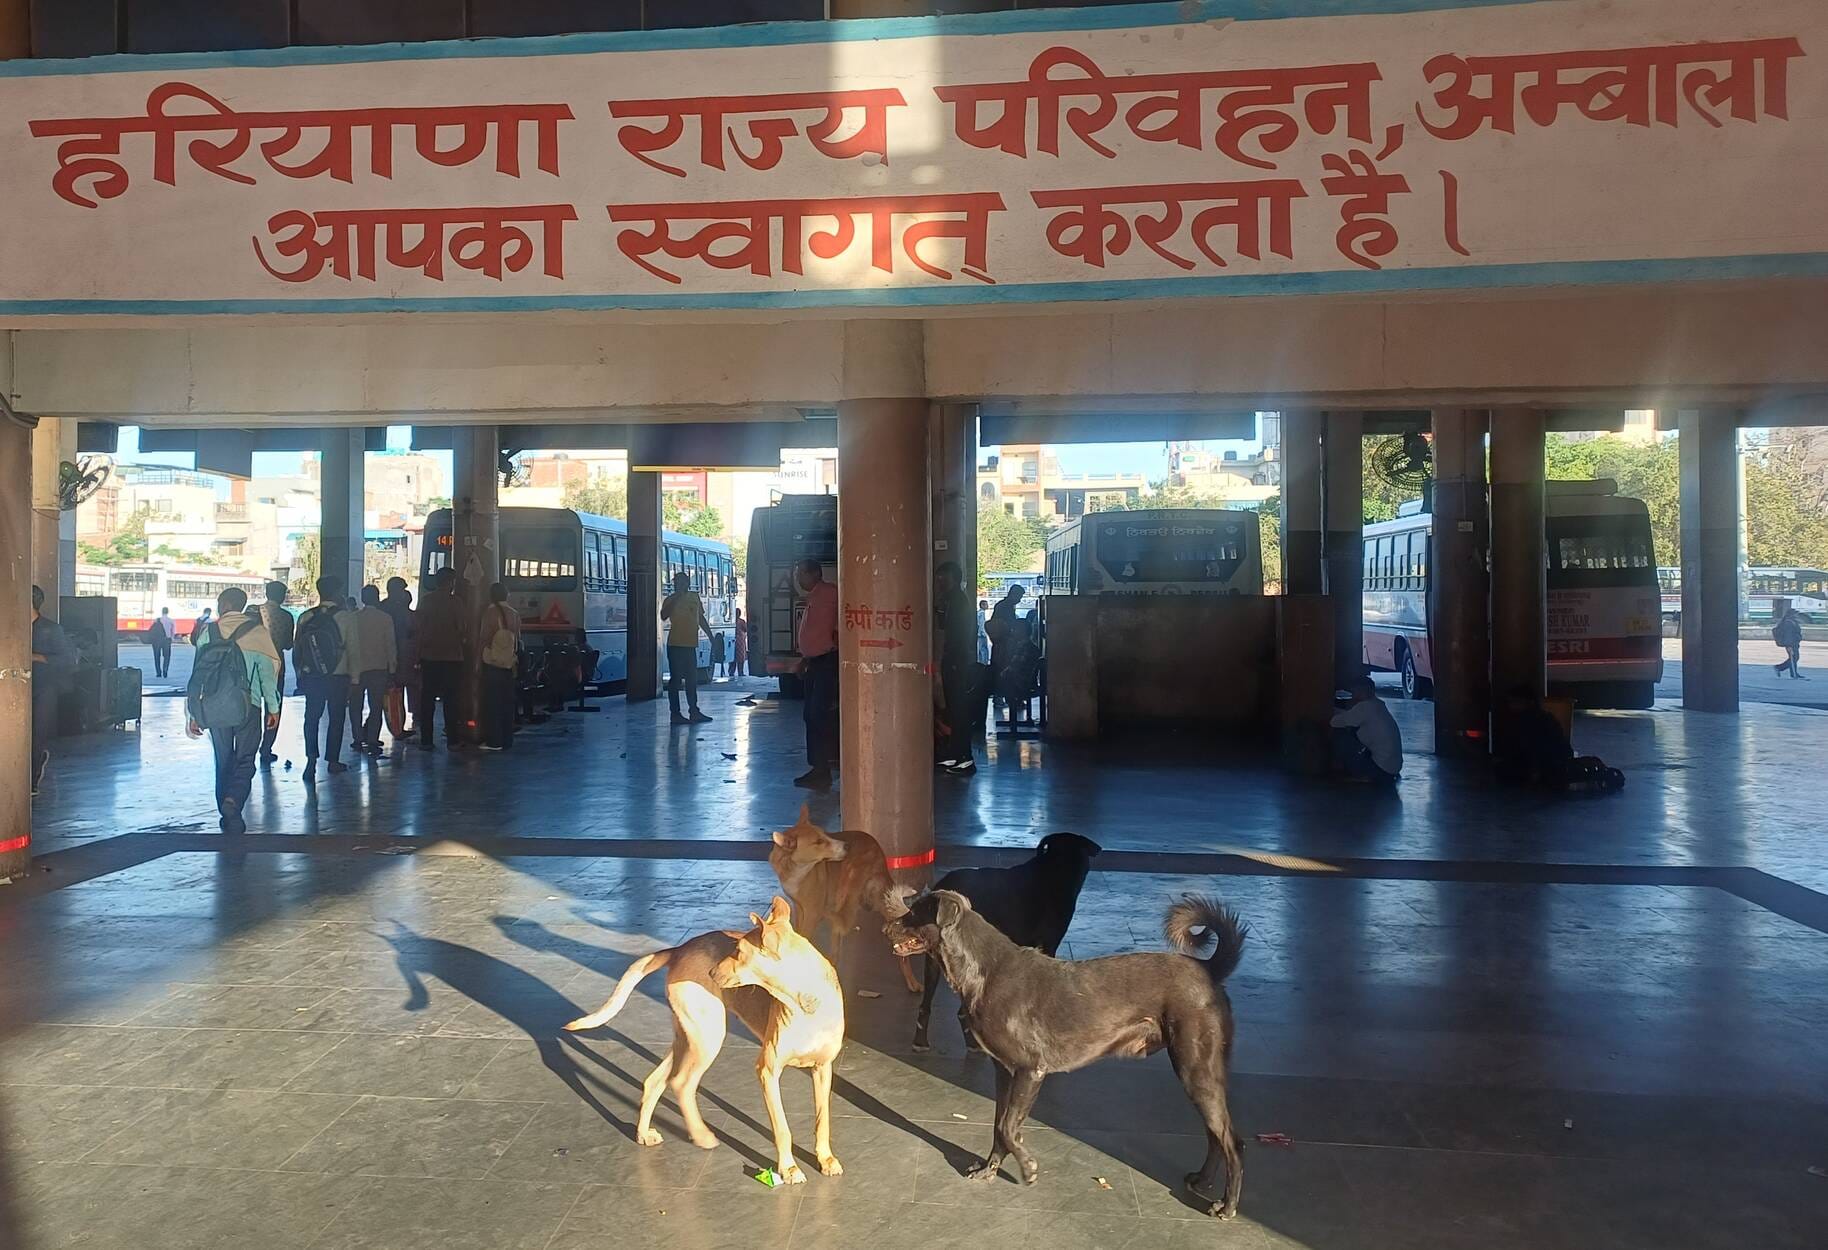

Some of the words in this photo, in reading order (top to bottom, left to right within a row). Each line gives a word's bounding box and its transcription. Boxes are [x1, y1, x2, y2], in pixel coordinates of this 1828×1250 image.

[28, 82, 575, 208] हरियाणा
[608, 87, 908, 178] राज्य
[1416, 37, 1806, 141] अम्बाला
[253, 204, 578, 283] आपका
[1030, 179, 1309, 271] करता
[875, 604, 914, 631] कार्ड
